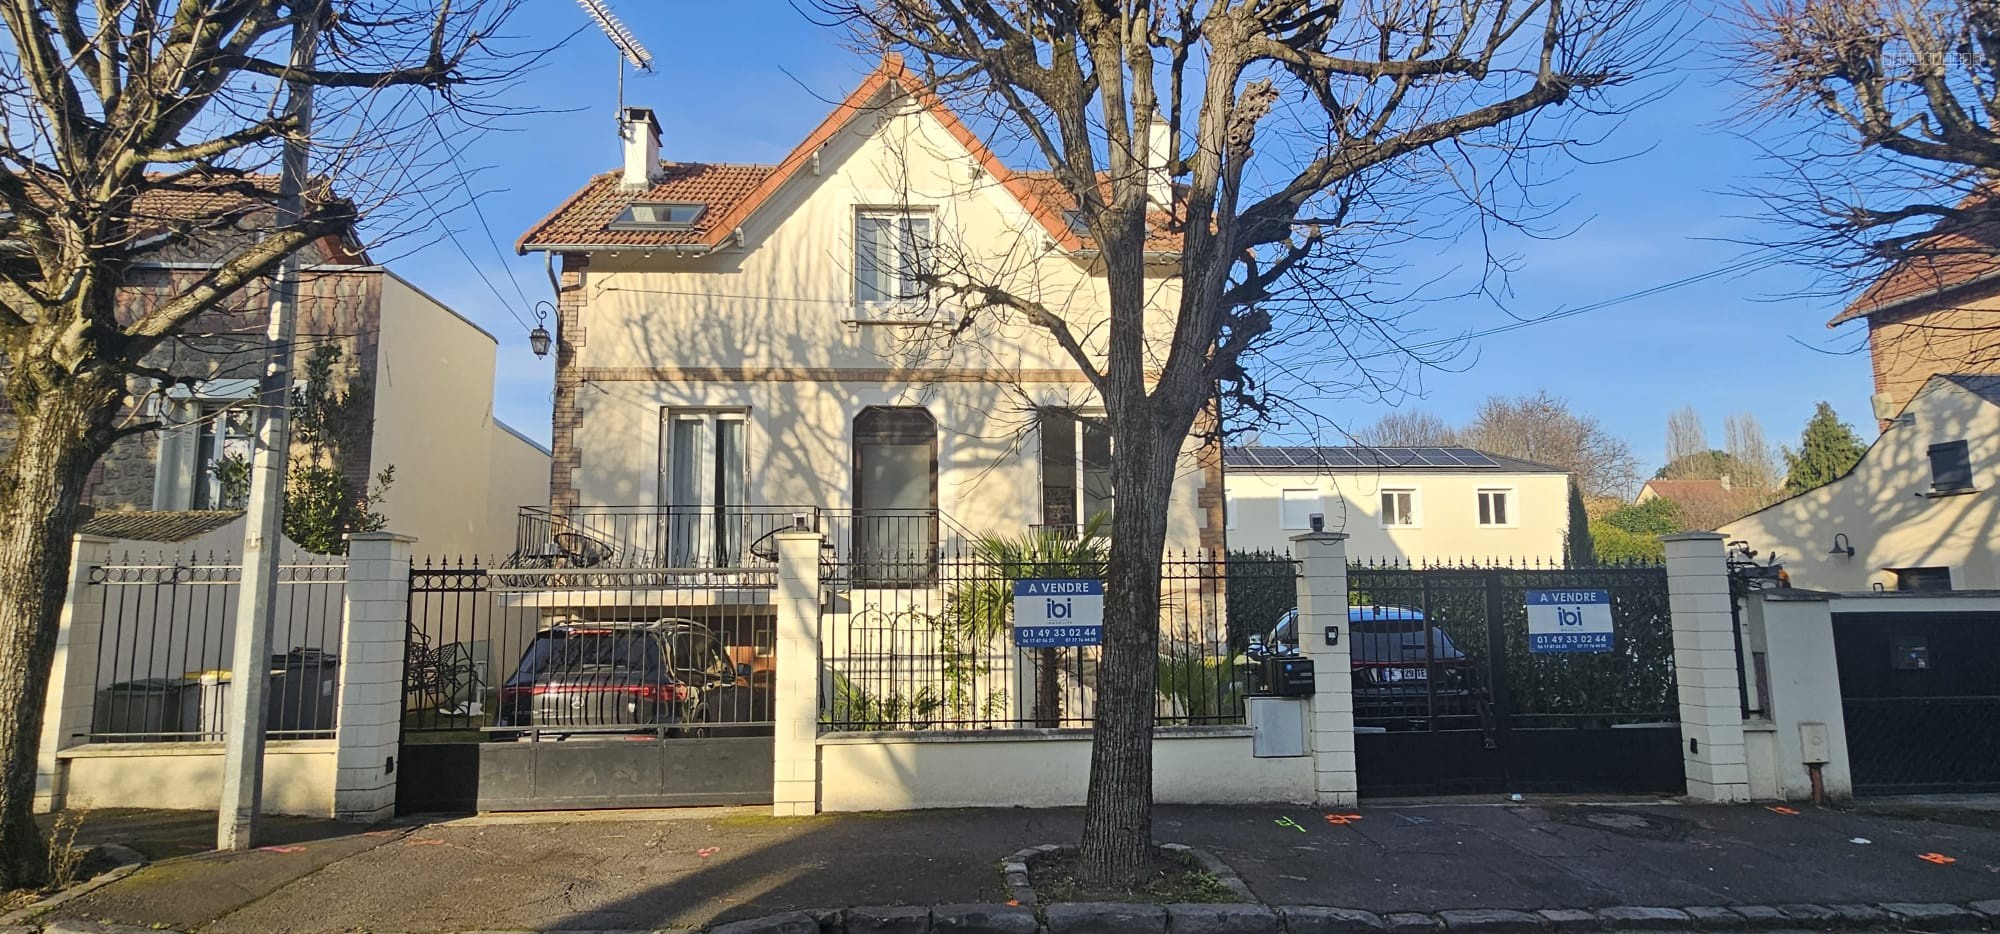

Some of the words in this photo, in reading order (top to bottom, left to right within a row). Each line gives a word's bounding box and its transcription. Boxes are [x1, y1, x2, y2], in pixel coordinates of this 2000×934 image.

[1028, 583, 1037, 593] A
[1041, 582, 1089, 593] VENDRE
[1540, 593, 1548, 602] A
[1552, 592, 1597, 602] VENDRE
[1046, 598, 1072, 618] ibi
[1557, 606, 1583, 626] ibi
[1022, 629, 1034, 638] 01
[1038, 629, 1050, 637] 49
[1054, 628, 1066, 636] 33
[1068, 628, 1080, 636] 02
[1084, 628, 1096, 636] 44
[1537, 636, 1548, 644] 01
[1552, 636, 1564, 644] 49
[1581, 635, 1592, 643] 02
